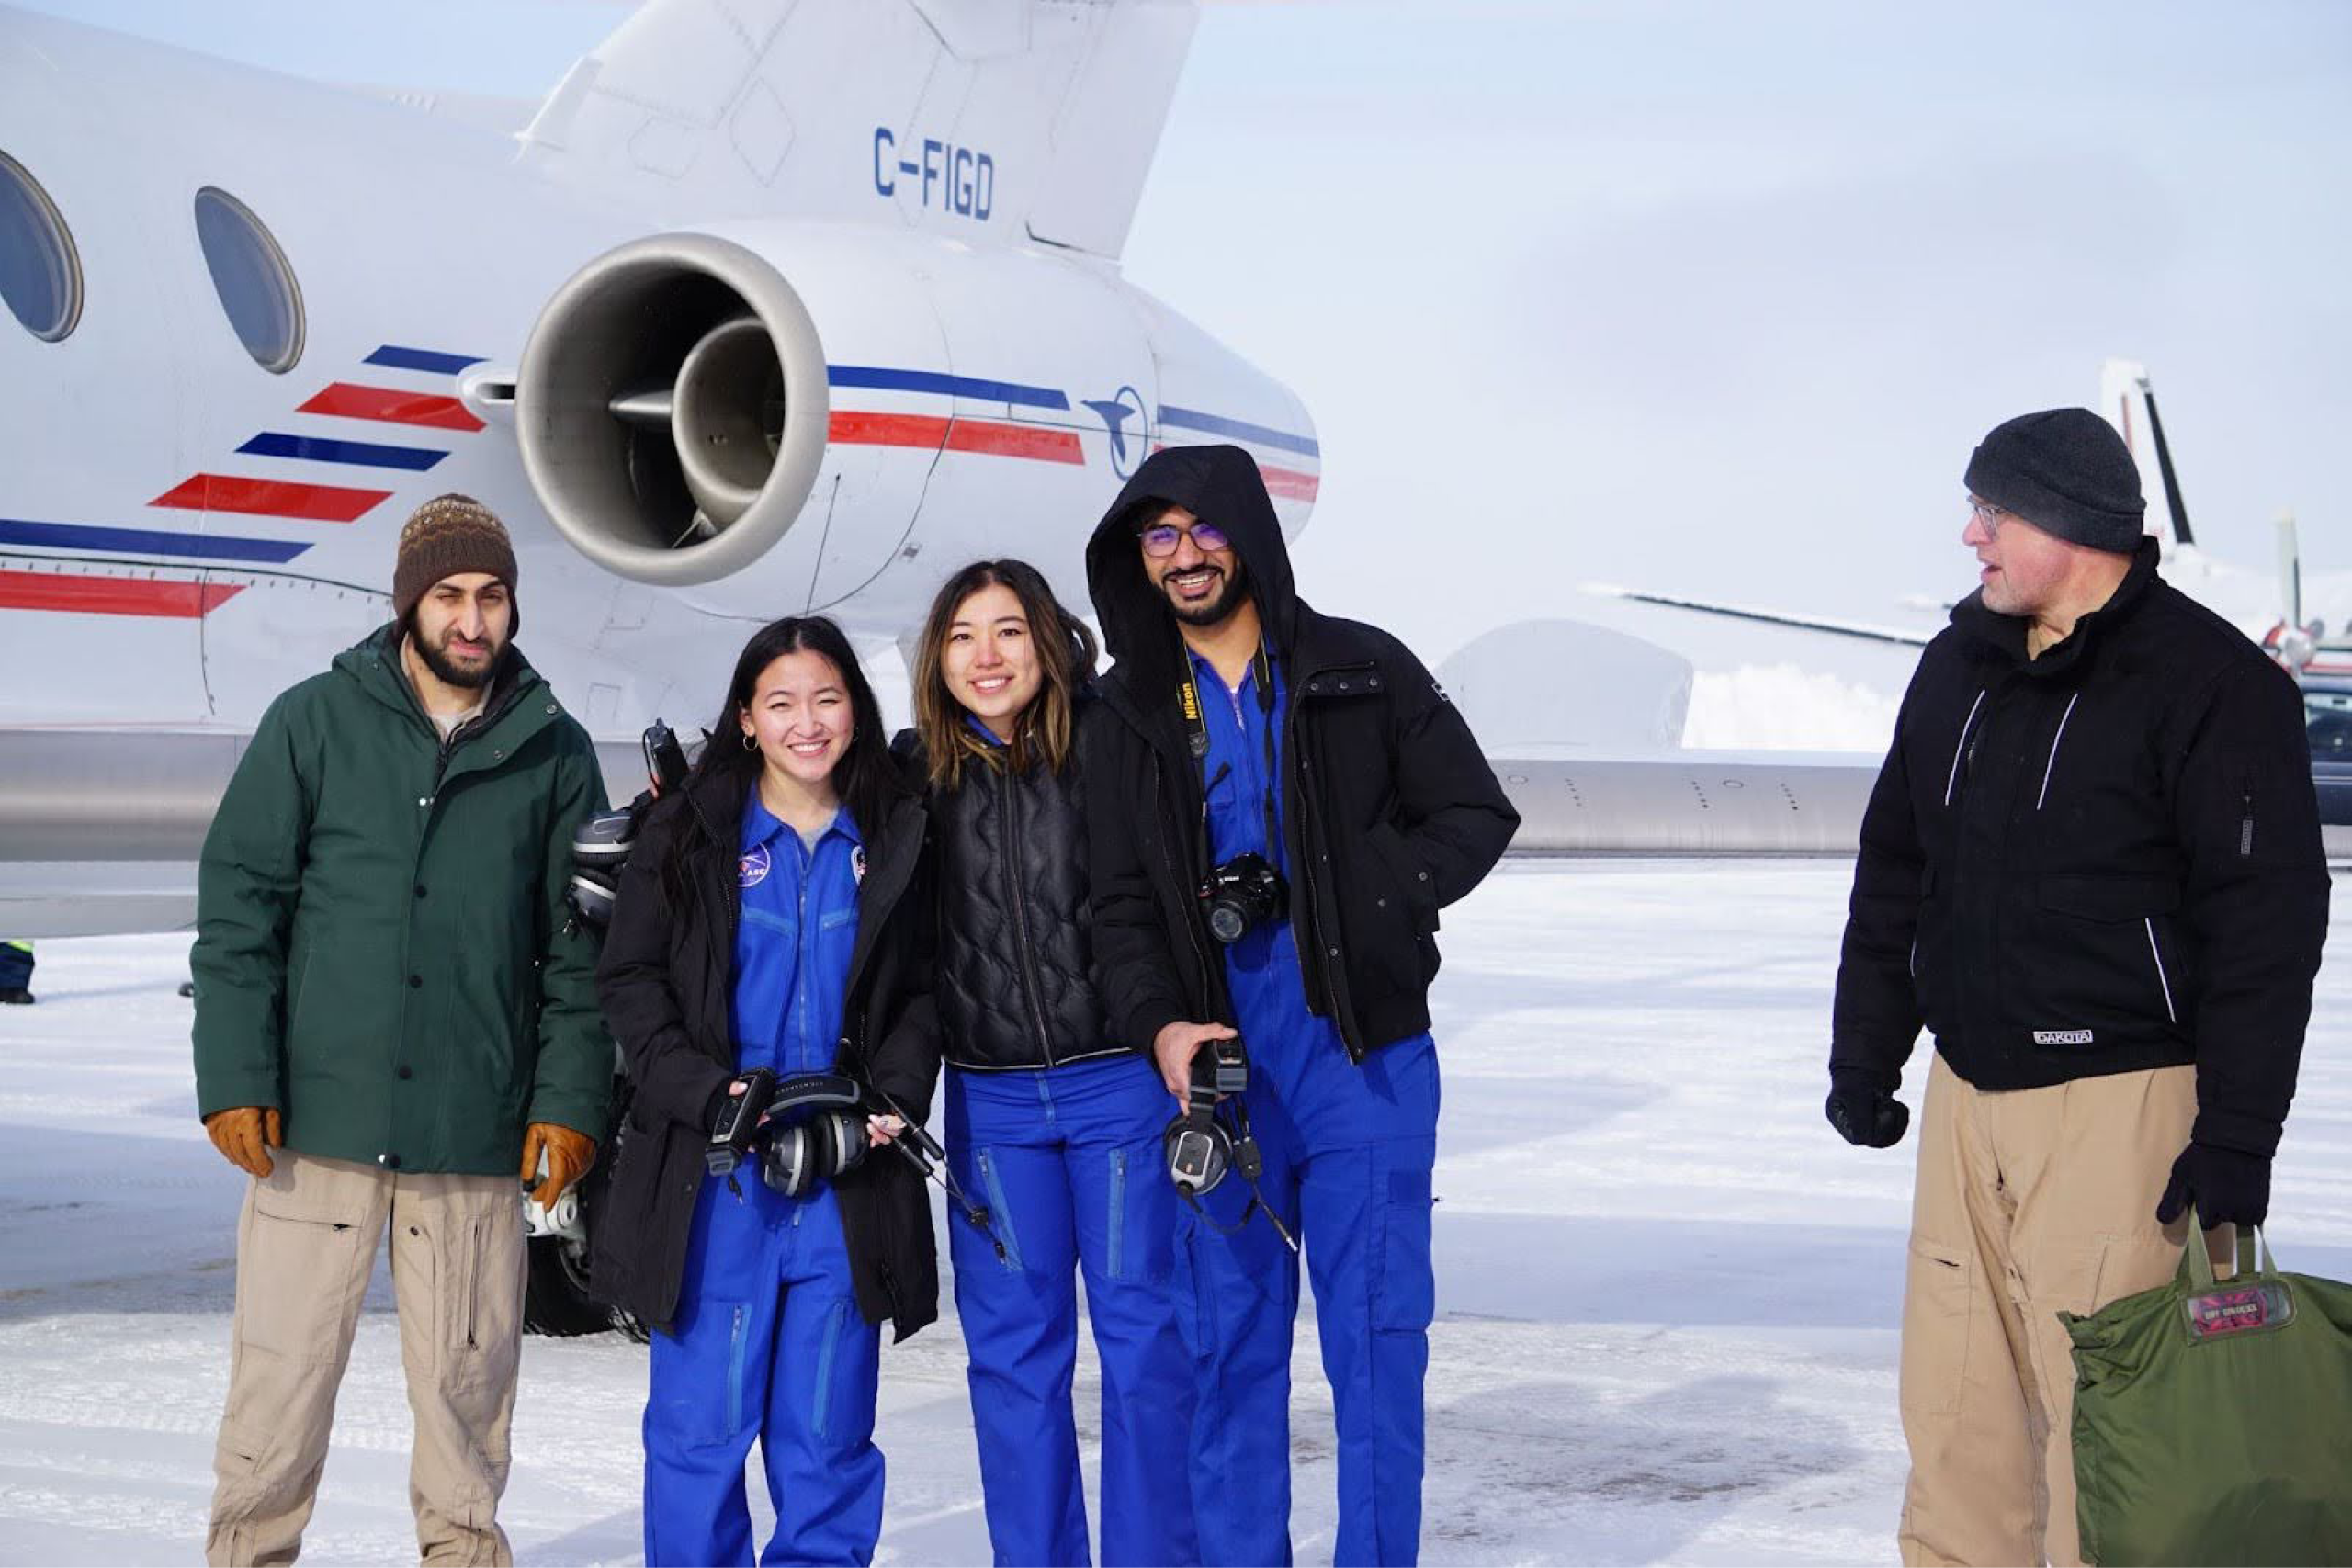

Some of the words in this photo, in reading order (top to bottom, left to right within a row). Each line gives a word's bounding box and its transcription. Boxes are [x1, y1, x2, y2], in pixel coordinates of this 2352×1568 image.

[875, 127, 994, 221] C-FIGD
[1182, 682, 1198, 720] Nikon
[2035, 1031, 2092, 1043] DAKOTA
